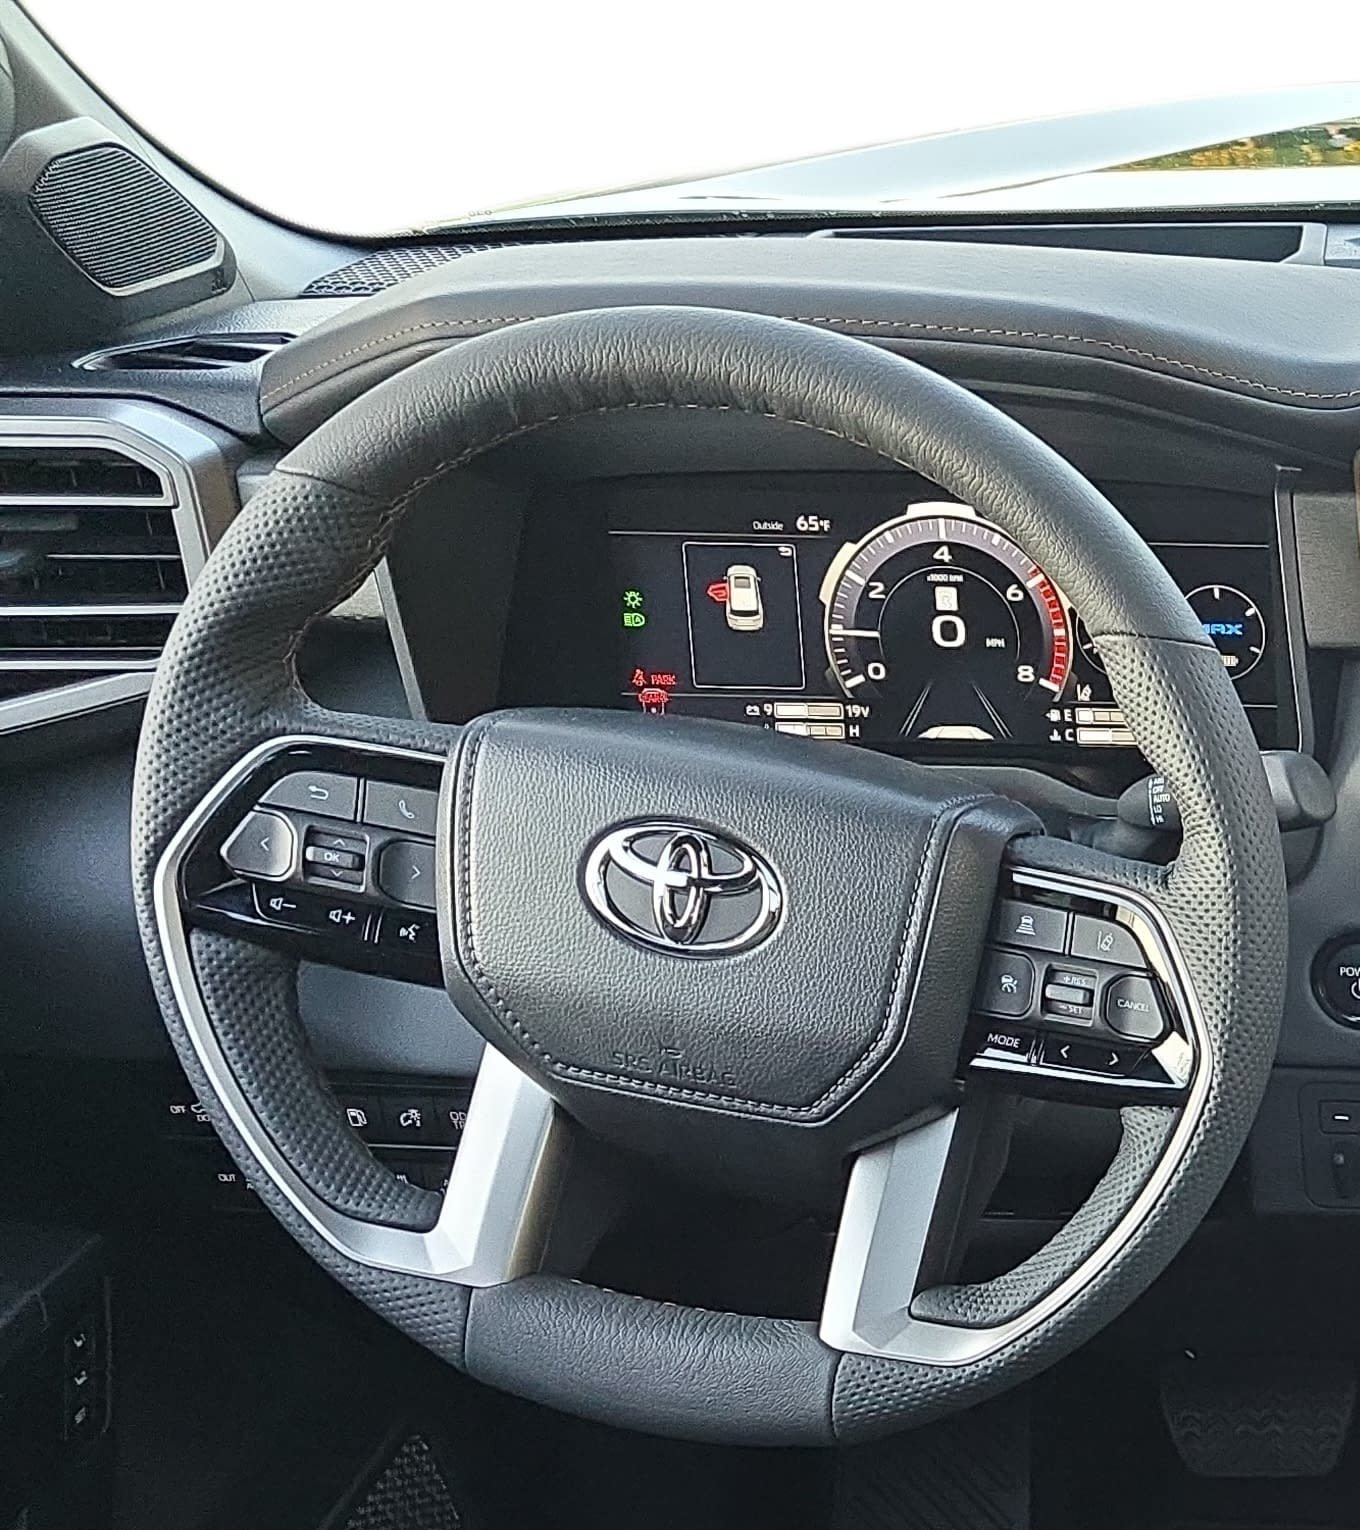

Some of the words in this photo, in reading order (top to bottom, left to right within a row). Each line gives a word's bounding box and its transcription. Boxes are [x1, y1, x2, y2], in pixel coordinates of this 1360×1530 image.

[753, 520, 784, 531] Outside
[932, 545, 953, 563] 4
[867, 581, 887, 600] 2
[1006, 583, 1025, 602] 6
[931, 614, 967, 648] 0
[867, 662, 886, 680] 0
[1016, 665, 1036, 683] 8
[1063, 708, 1073, 722] E
[849, 725, 861, 738] H
[1064, 729, 1075, 742] C
[323, 851, 341, 863] OK
[987, 1032, 1022, 1048] MODE
